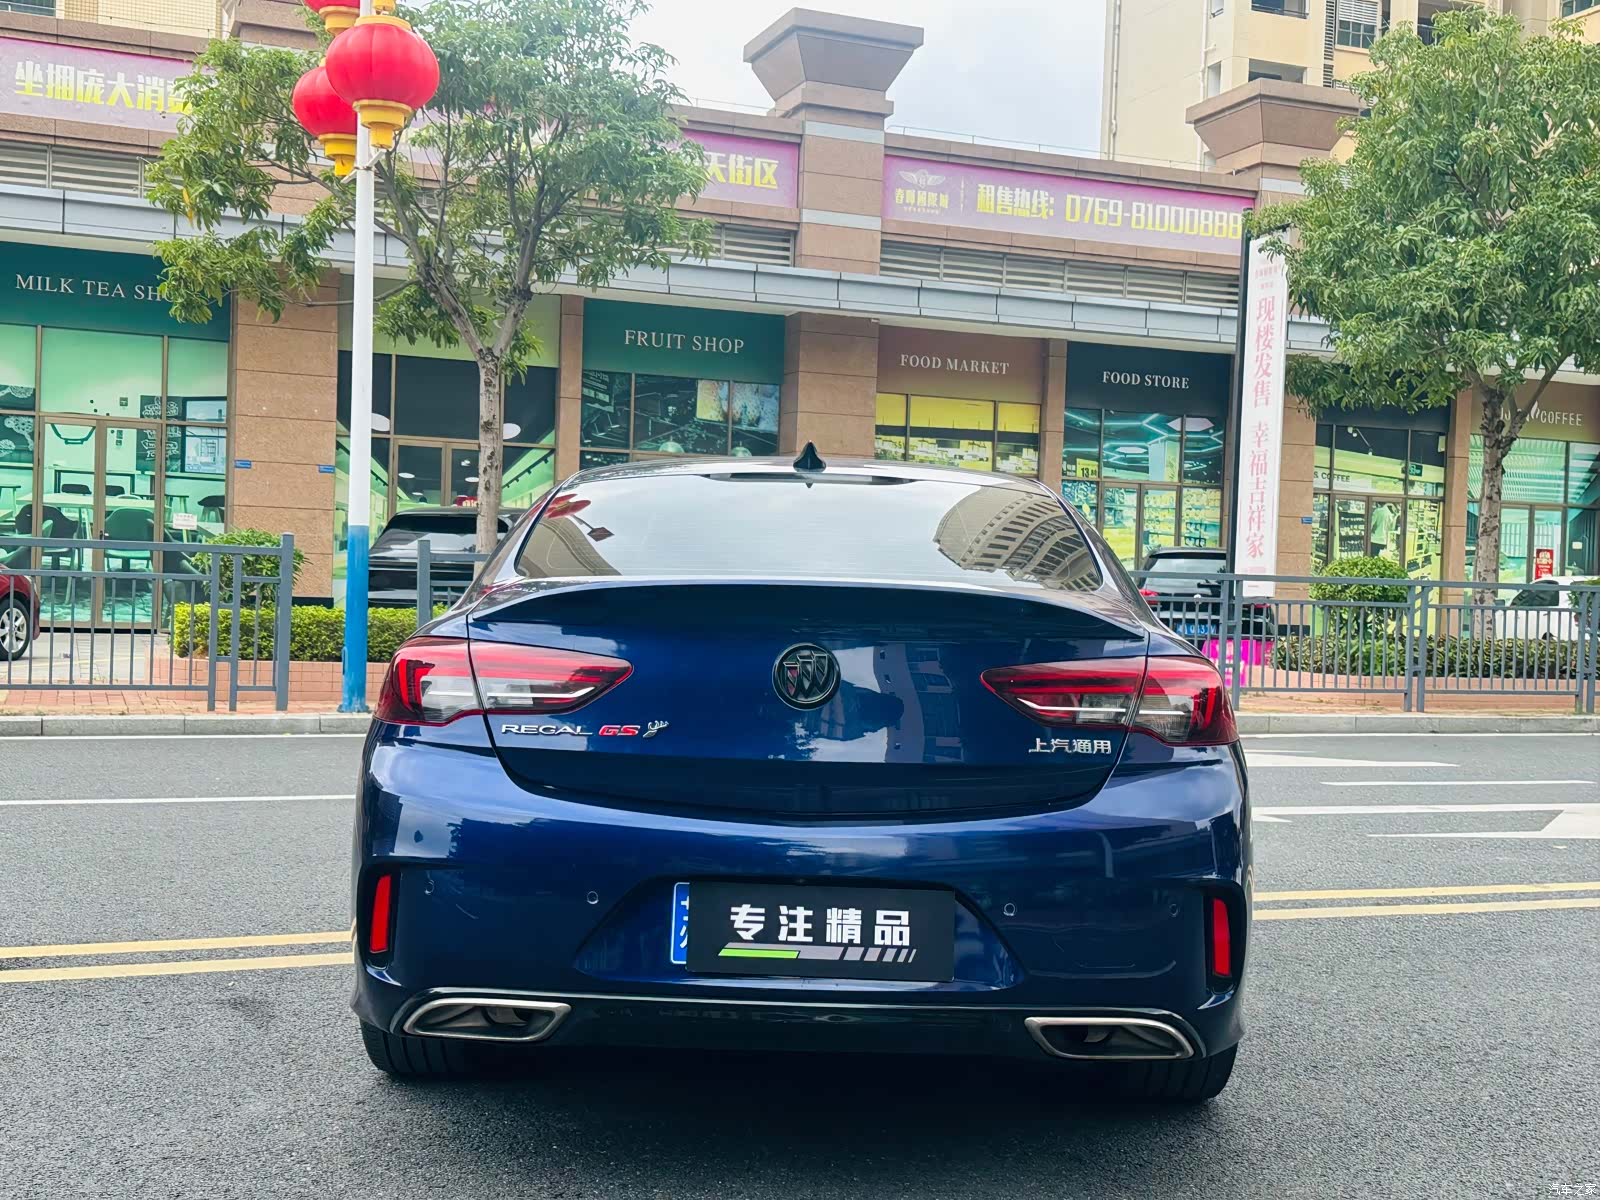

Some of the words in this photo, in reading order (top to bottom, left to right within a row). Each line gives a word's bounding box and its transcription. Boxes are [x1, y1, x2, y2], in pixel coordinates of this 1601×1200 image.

[1065, 194, 1242, 240] 0769-81000888
[16, 274, 74, 294] MILK
[83, 280, 126, 298] TEA
[624, 329, 686, 350] FRUIT
[691, 335, 745, 354] SHOP
[1254, 296, 1275, 409] 现楼发售
[900, 354, 942, 369] FOOD
[945, 358, 1010, 375] MARKET
[1102, 371, 1141, 385] FOOD
[1144, 374, 1190, 389] STORE
[1540, 410, 1584, 427] COFFEE
[1246, 420, 1269, 559] 幸福吉祥家
[501, 724, 593, 736] REGAL
[598, 724, 641, 737] GS
[1028, 737, 1112, 754] 上汽通用
[730, 903, 910, 946] 专注精品
